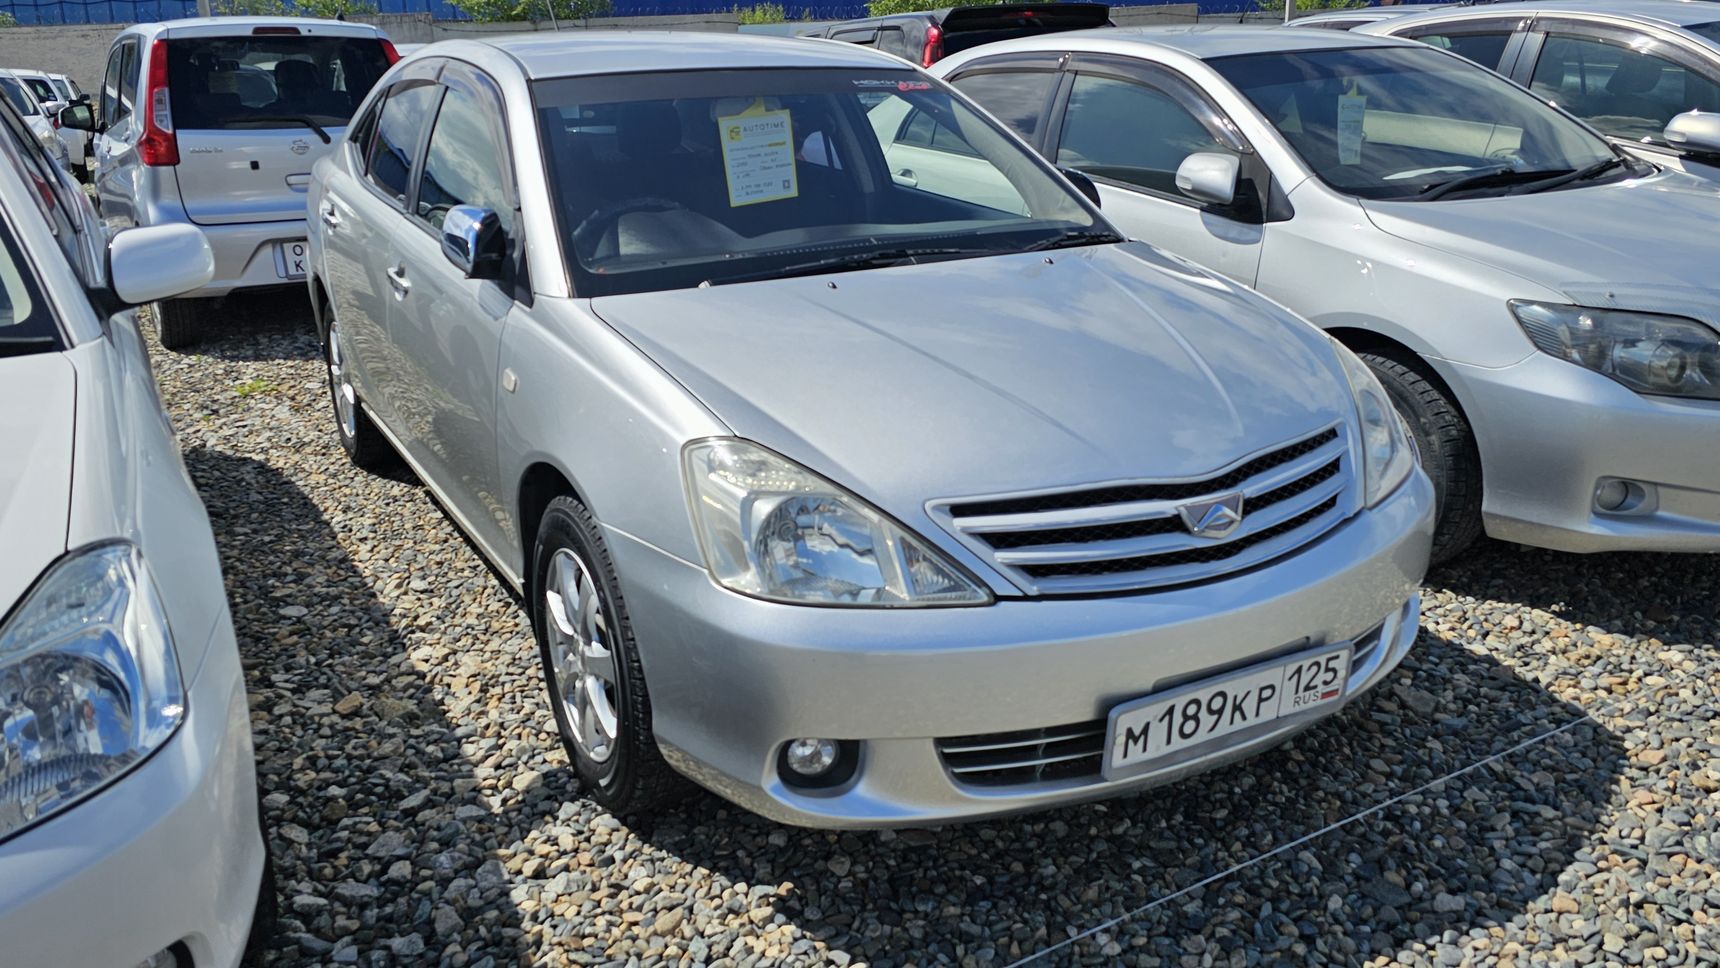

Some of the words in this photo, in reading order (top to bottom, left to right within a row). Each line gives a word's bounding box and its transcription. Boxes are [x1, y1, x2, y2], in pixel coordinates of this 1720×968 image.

[743, 121, 786, 133] AUTOTIME
[1287, 654, 1341, 696] 125
[1293, 691, 1320, 708] RUS
